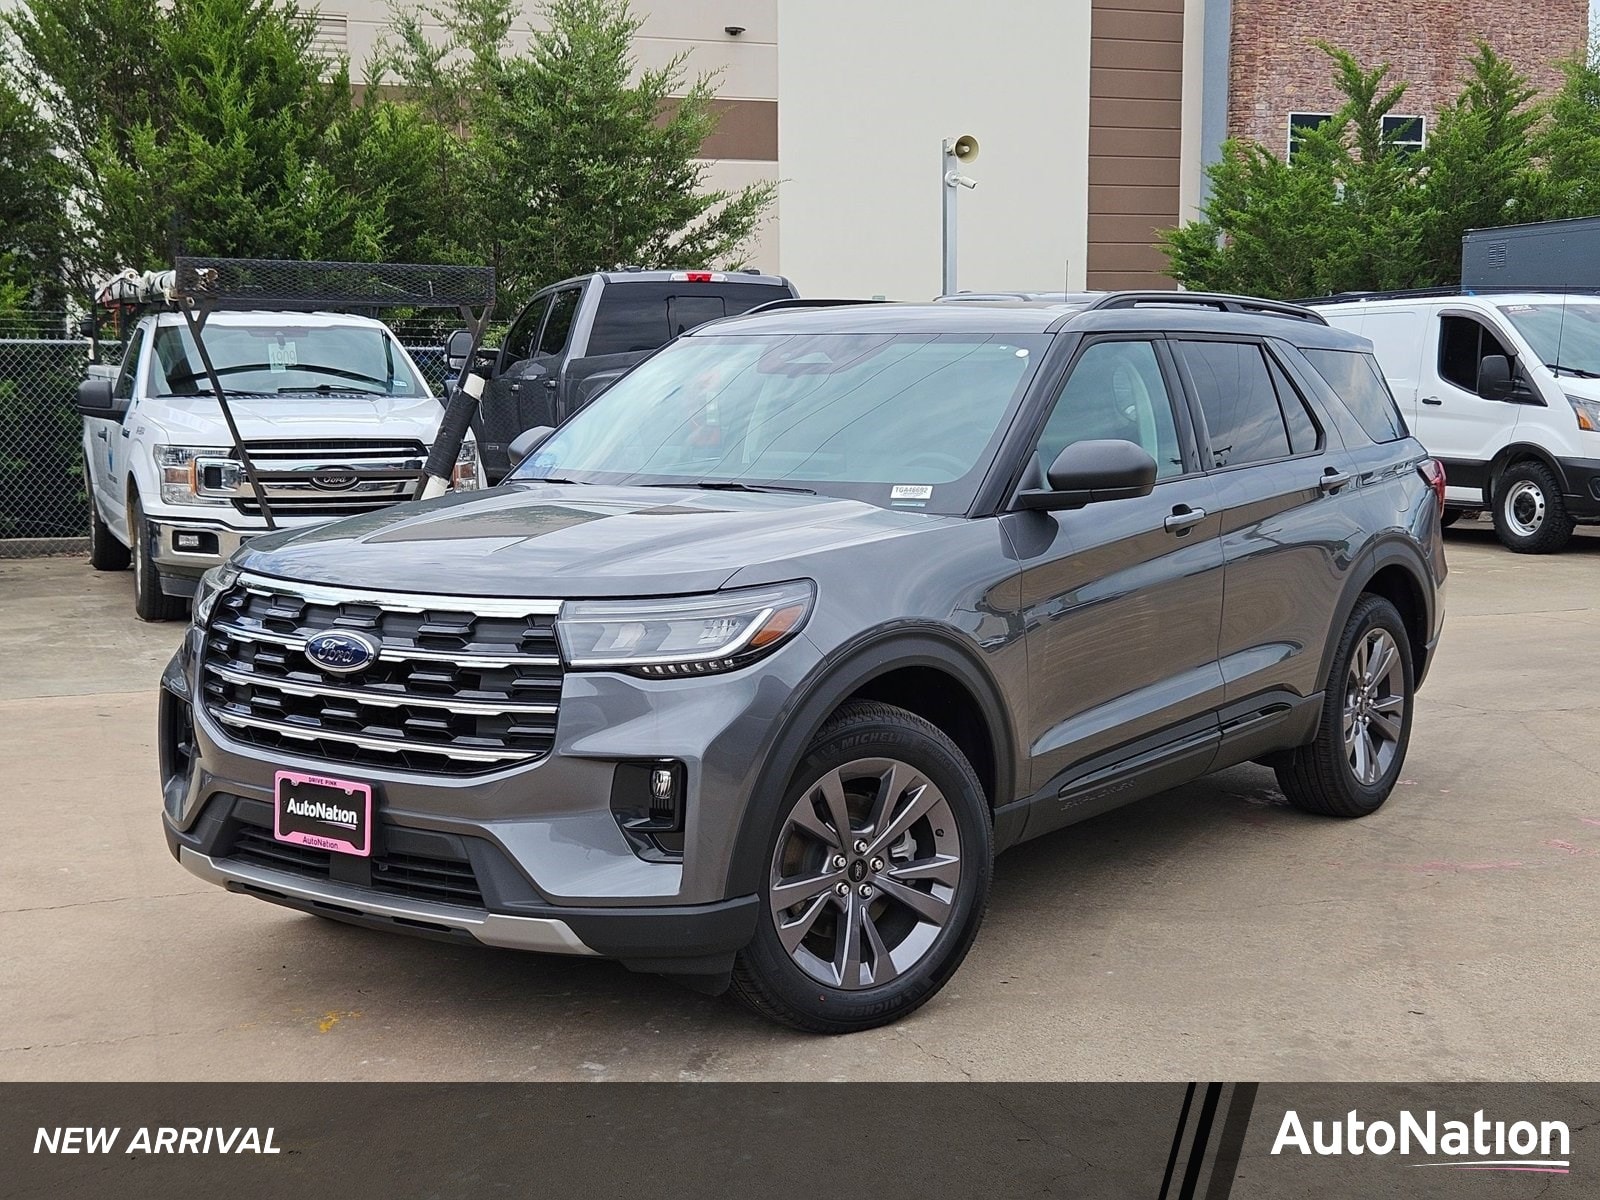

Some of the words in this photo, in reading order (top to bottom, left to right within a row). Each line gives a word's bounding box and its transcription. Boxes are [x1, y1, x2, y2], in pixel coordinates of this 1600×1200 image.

[317, 638, 354, 663] Ford
[286, 797, 358, 824] AutoNation
[302, 836, 338, 848] AutoNation
